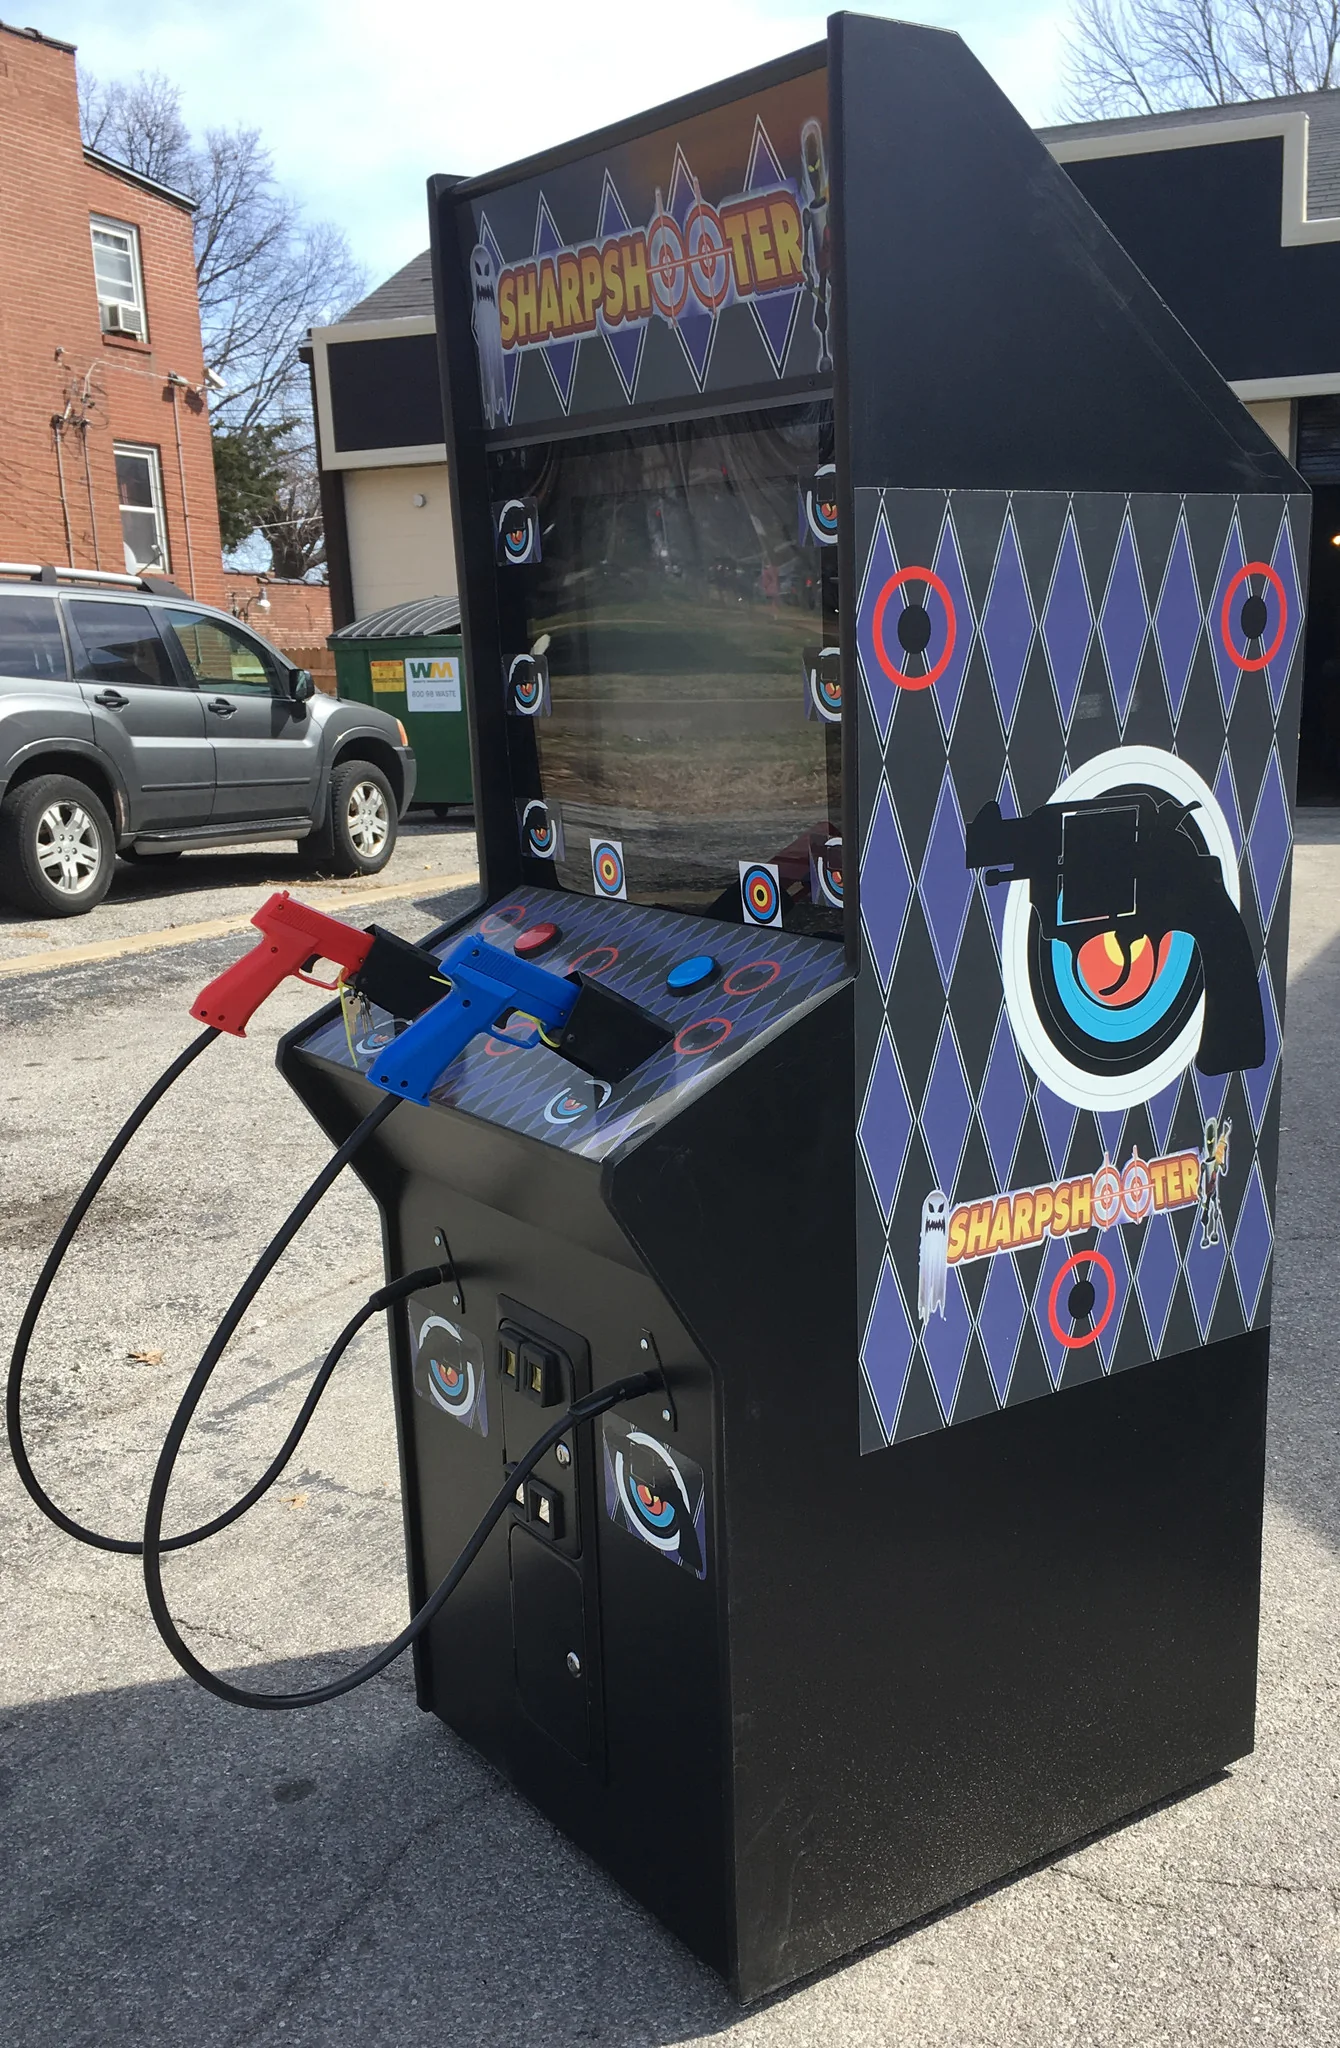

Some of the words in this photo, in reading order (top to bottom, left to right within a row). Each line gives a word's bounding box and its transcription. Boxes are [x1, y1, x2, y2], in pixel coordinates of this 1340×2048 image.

[499, 192, 806, 349] SHARPSHOOTER
[409, 662, 454, 678] WM
[411, 690, 425, 698] 800
[435, 690, 457, 698] WASTE
[947, 1154, 1199, 1261] SHARPSHOOTER
